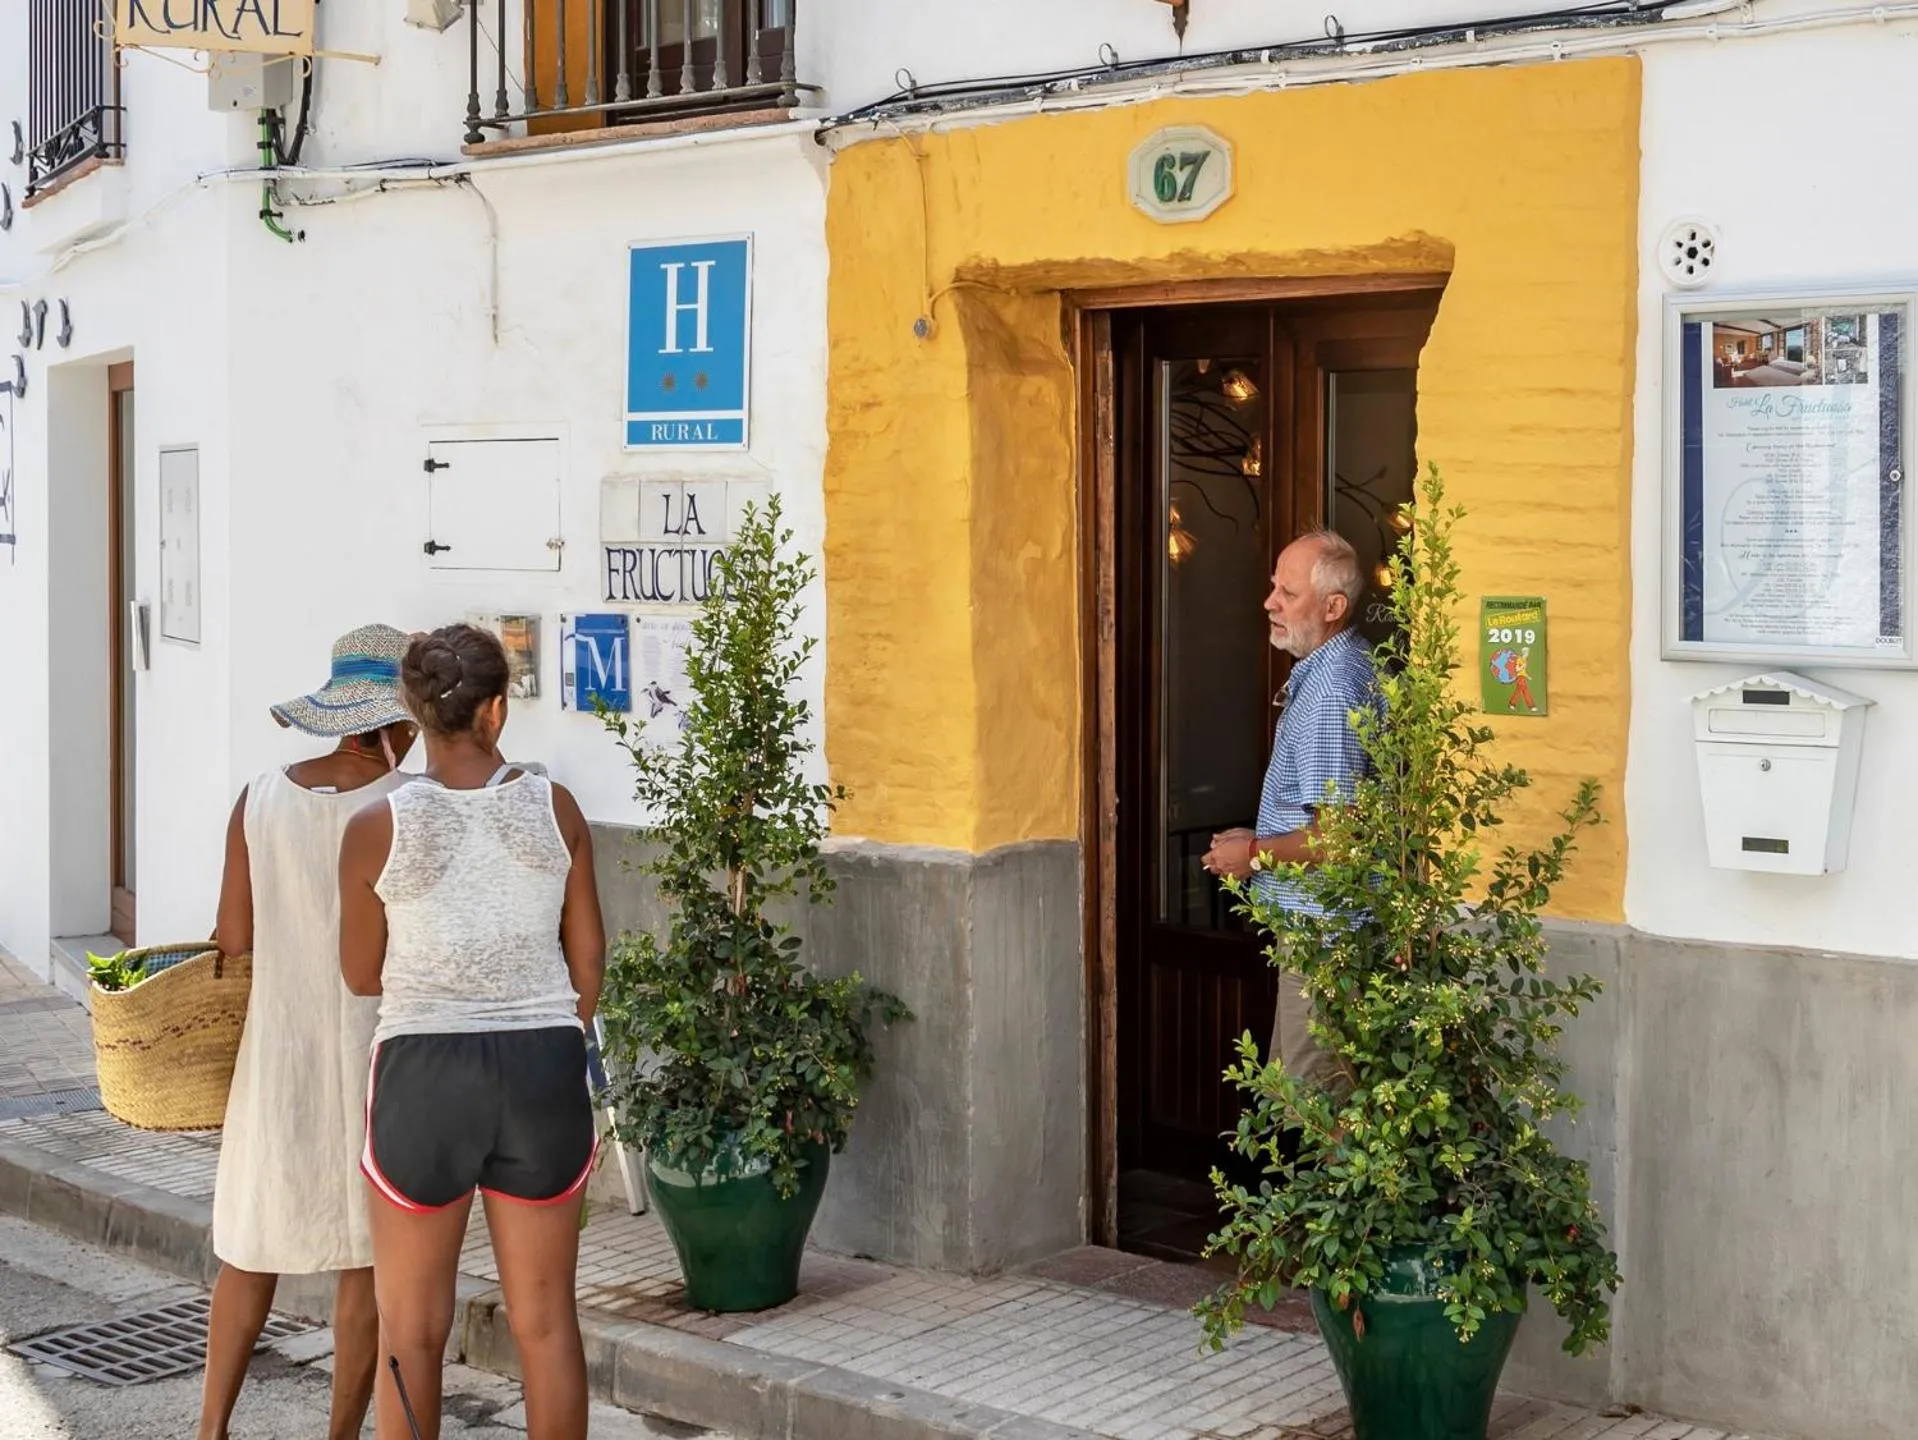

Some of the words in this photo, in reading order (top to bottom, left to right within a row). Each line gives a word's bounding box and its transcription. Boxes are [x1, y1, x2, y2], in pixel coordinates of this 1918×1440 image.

[1154, 150, 1211, 203] 67
[658, 260, 716, 353] H
[651, 423, 718, 441] RURAL
[662, 493, 706, 535] LA
[1488, 628, 1536, 644] 2019
[572, 634, 628, 692] M
